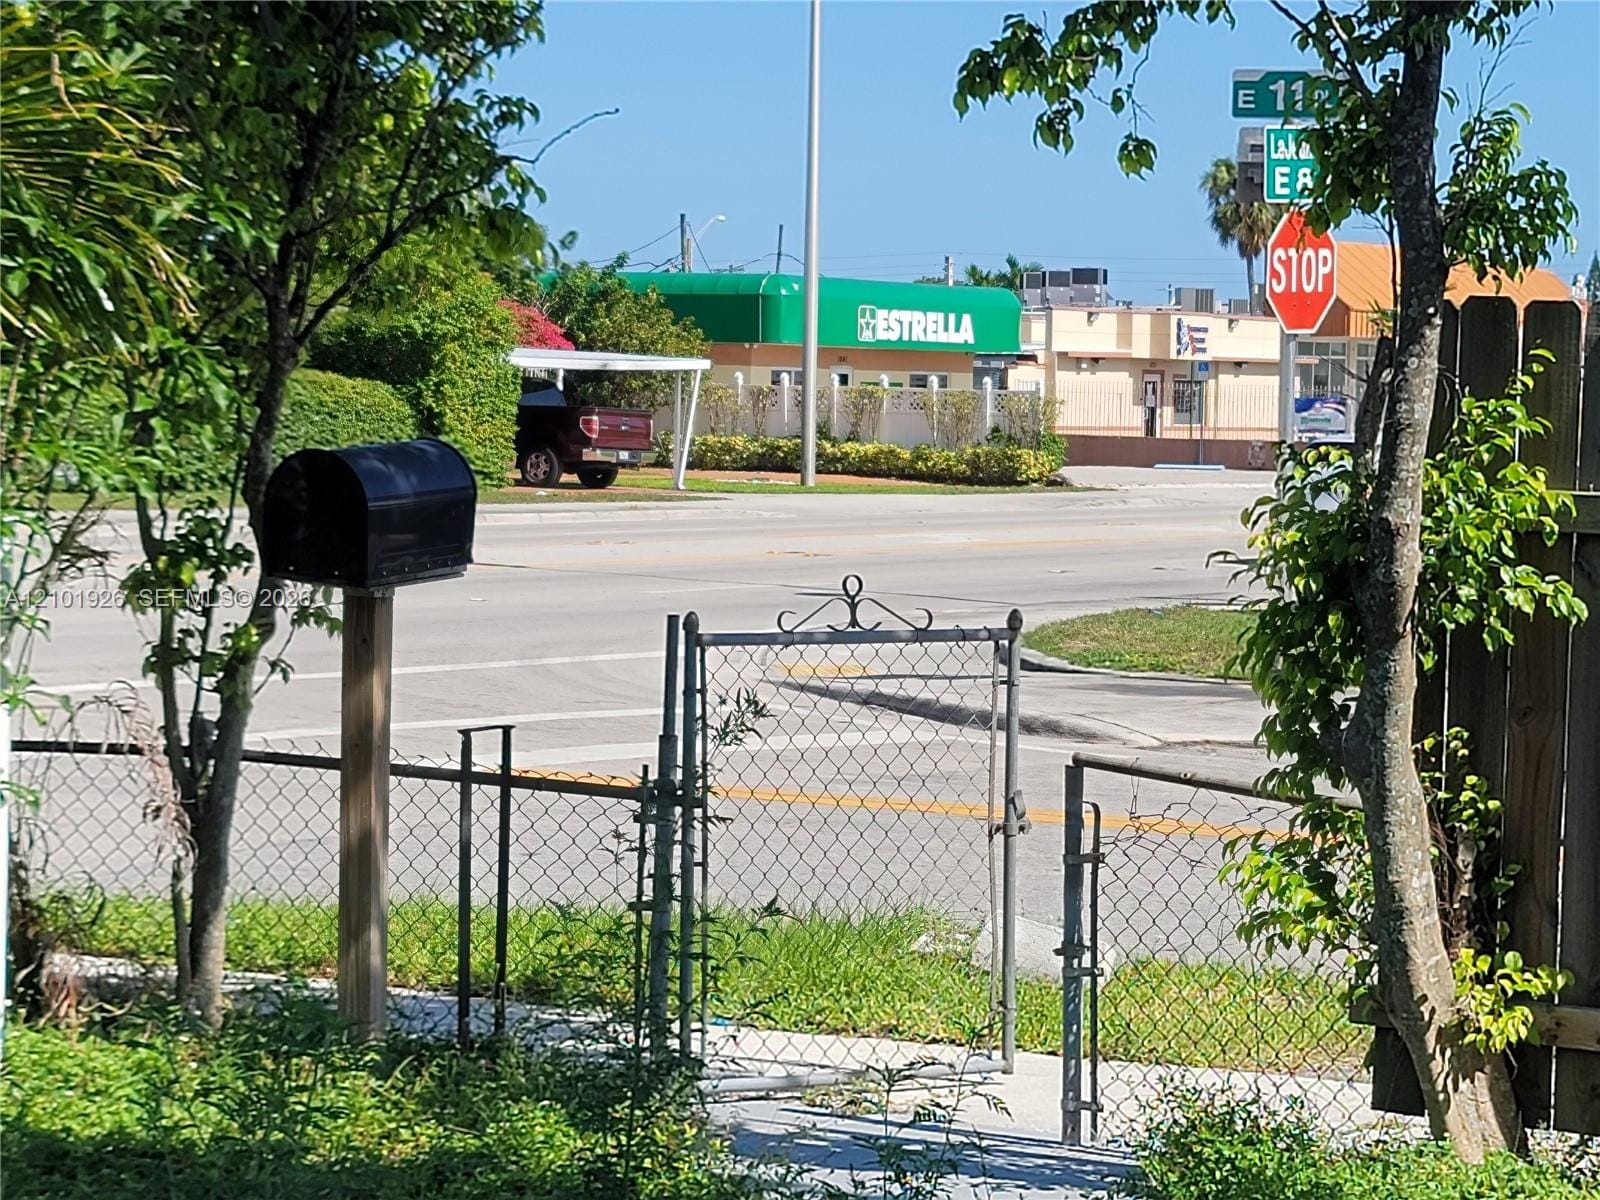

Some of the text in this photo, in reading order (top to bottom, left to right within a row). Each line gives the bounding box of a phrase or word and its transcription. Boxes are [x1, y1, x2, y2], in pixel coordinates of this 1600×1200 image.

[1237, 90, 1256, 109] E
[1274, 166, 1291, 195] E
[1271, 247, 1333, 294] STOP
[877, 308, 976, 345] ESTRELLA
